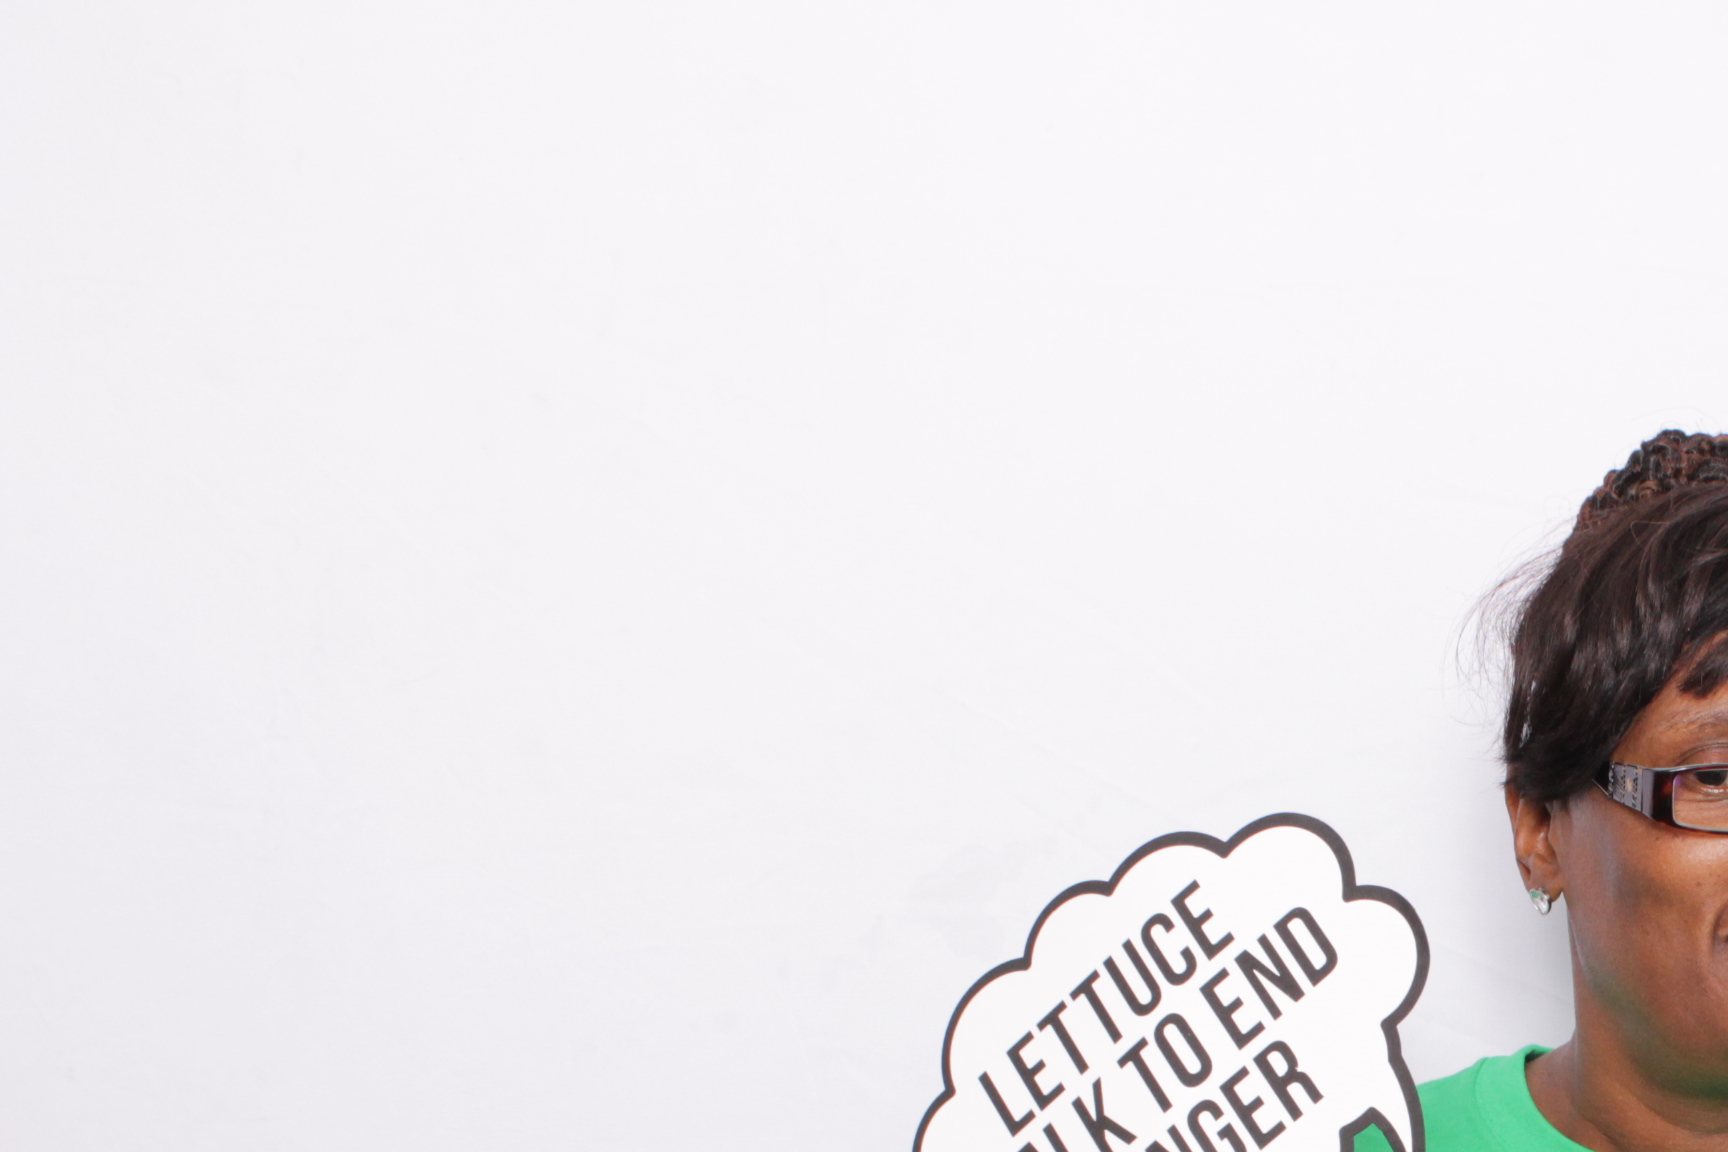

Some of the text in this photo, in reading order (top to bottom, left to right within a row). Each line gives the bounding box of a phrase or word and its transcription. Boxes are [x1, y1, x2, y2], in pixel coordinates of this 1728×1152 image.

[978, 879, 1235, 1138] LETTUCE
[1117, 1012, 1213, 1113] TO
[1200, 906, 1338, 1051] END
